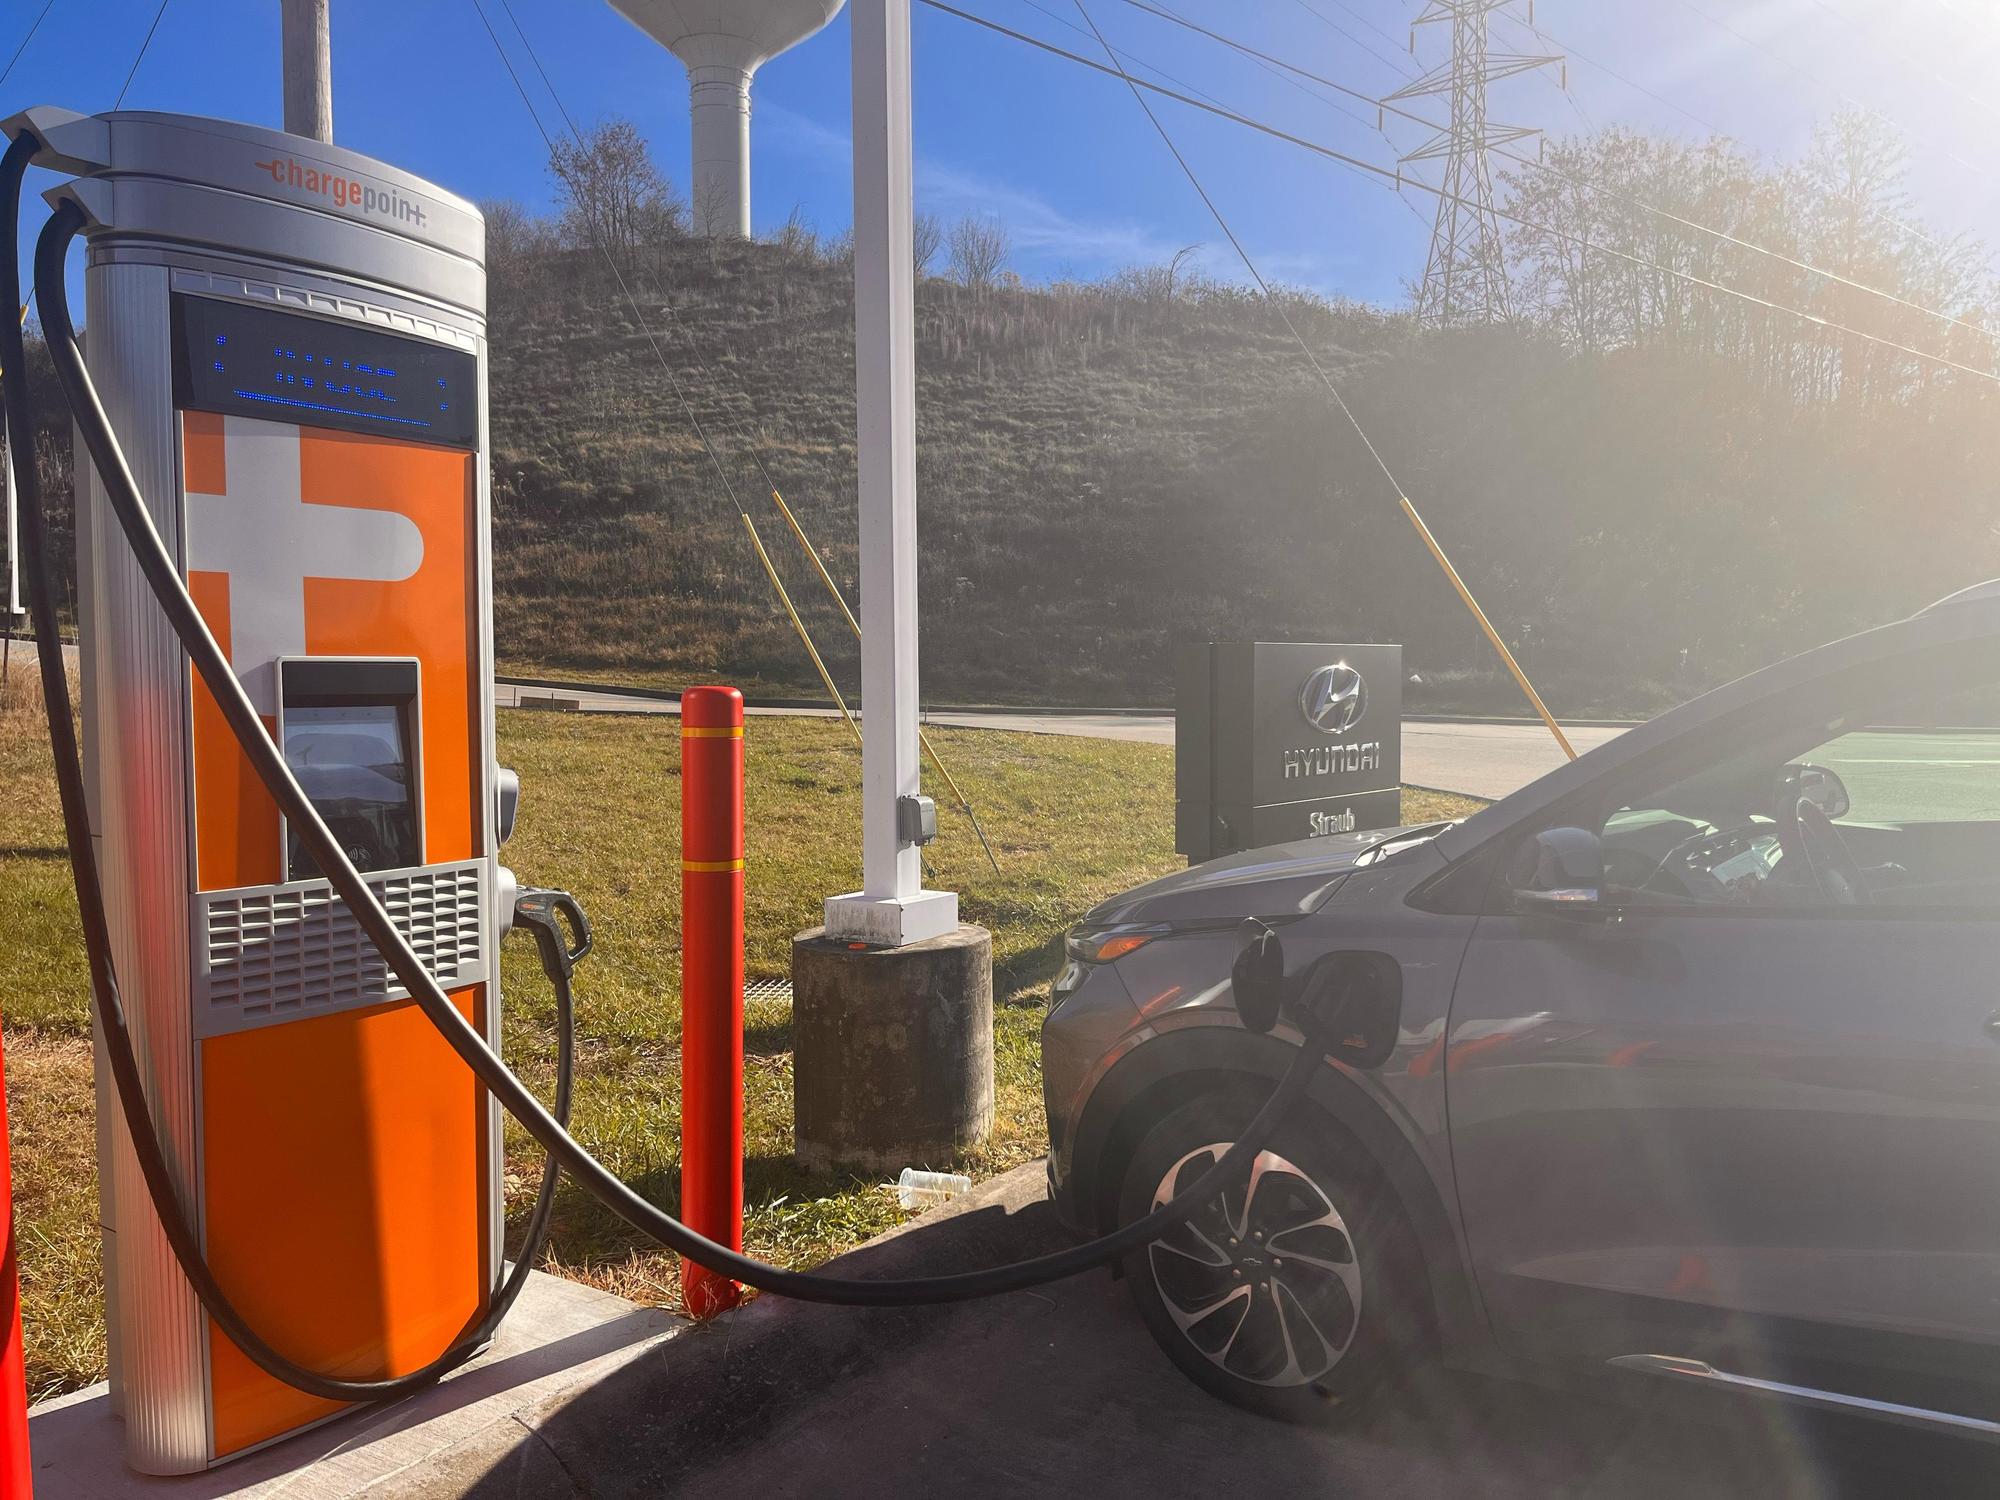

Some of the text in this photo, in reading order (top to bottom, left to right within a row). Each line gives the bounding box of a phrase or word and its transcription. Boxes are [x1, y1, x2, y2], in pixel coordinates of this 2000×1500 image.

[255, 158, 427, 226] chargepoint
[1284, 742, 1380, 778] HYUNDAI
[1309, 807, 1356, 838] Straub
